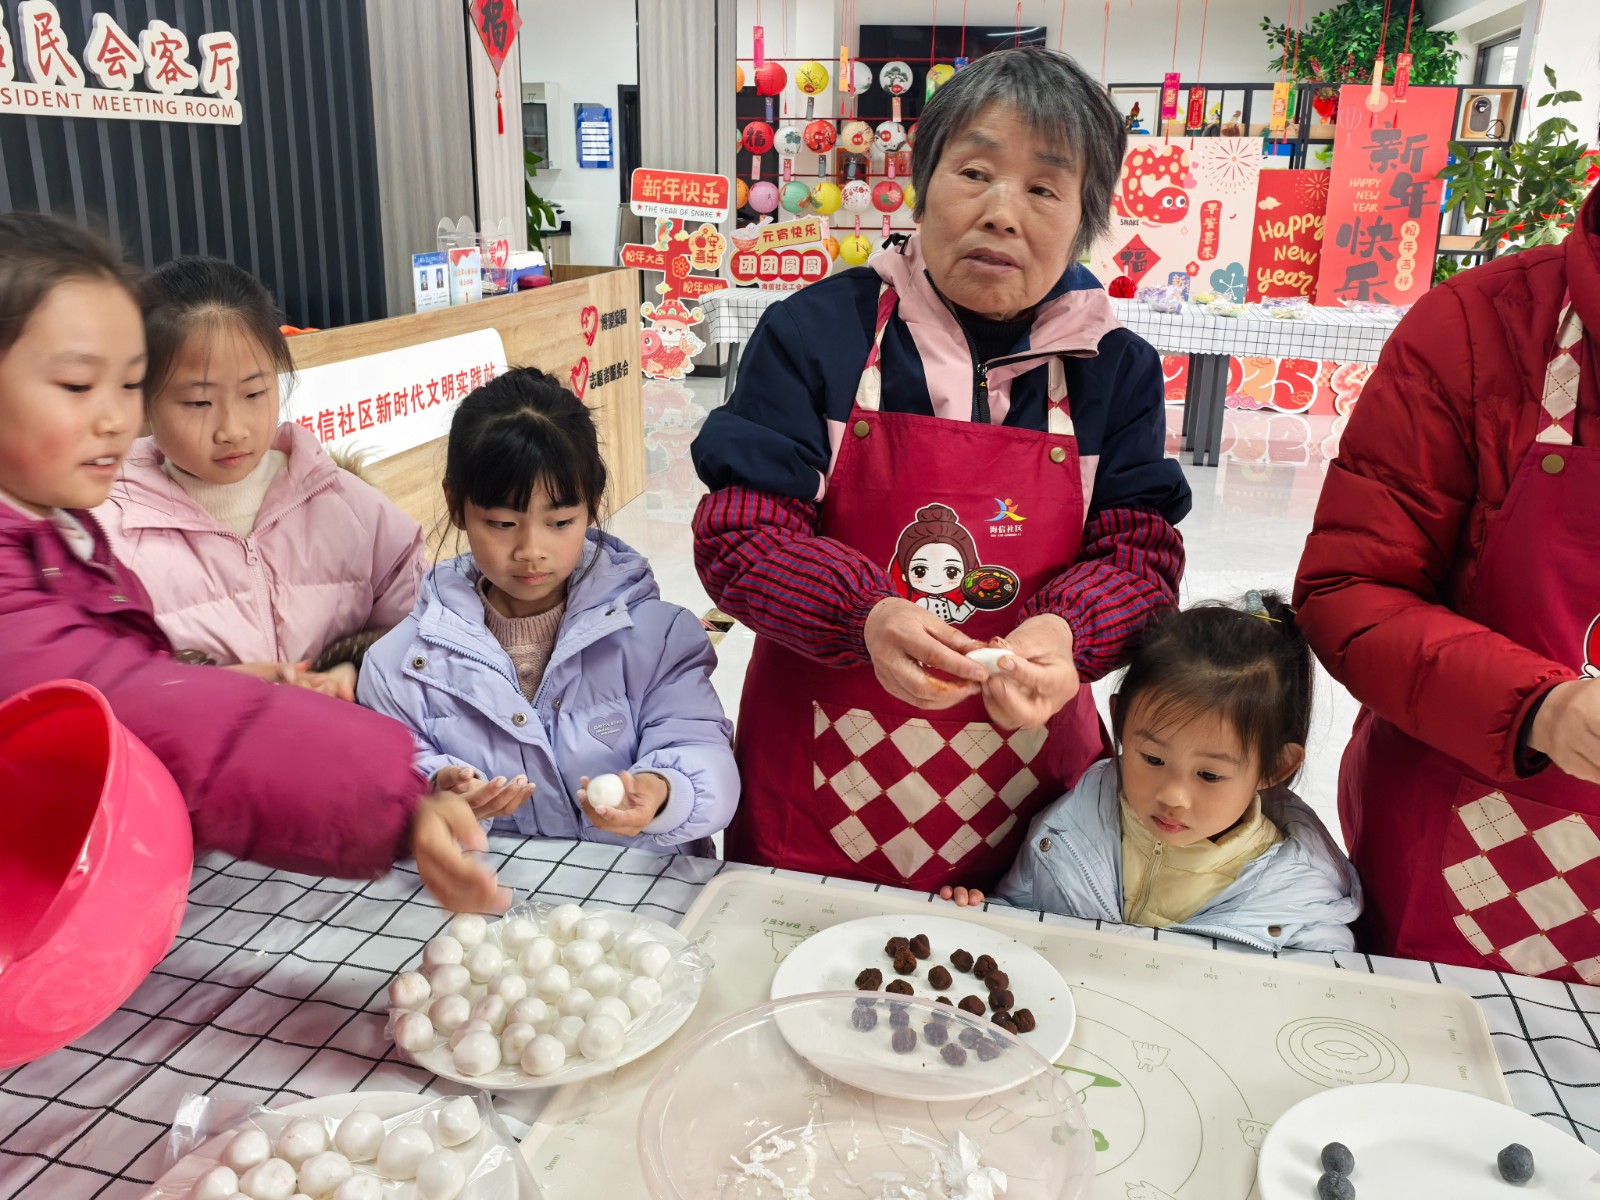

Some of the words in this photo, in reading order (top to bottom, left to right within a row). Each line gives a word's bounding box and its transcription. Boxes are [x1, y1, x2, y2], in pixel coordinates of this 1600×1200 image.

[0, 12, 233, 91] 民会客厅
[0, 87, 82, 109] SIDENT
[93, 95, 177, 115] MEETING
[186, 102, 234, 118] ROOM
[641, 174, 720, 205] 新年快乐
[1349, 178, 1381, 189] HAPPY
[1356, 190, 1379, 200] NEW
[644, 205, 657, 214] THE
[660, 206, 678, 215] YEAR
[680, 208, 687, 216] OF
[691, 209, 713, 218] SNAKE
[1353, 202, 1378, 213] YEAR
[1120, 218, 1140, 226] SNAKE
[762, 223, 817, 243] 元宵快乐
[625, 249, 665, 265] 蛇年大吉
[1119, 246, 1151, 274] 福
[739, 255, 822, 276] 团团圆圆
[989, 524, 1023, 534] 海信社区
[762, 917, 801, 929] BAKE!
[1262, 981, 1278, 989] 100
